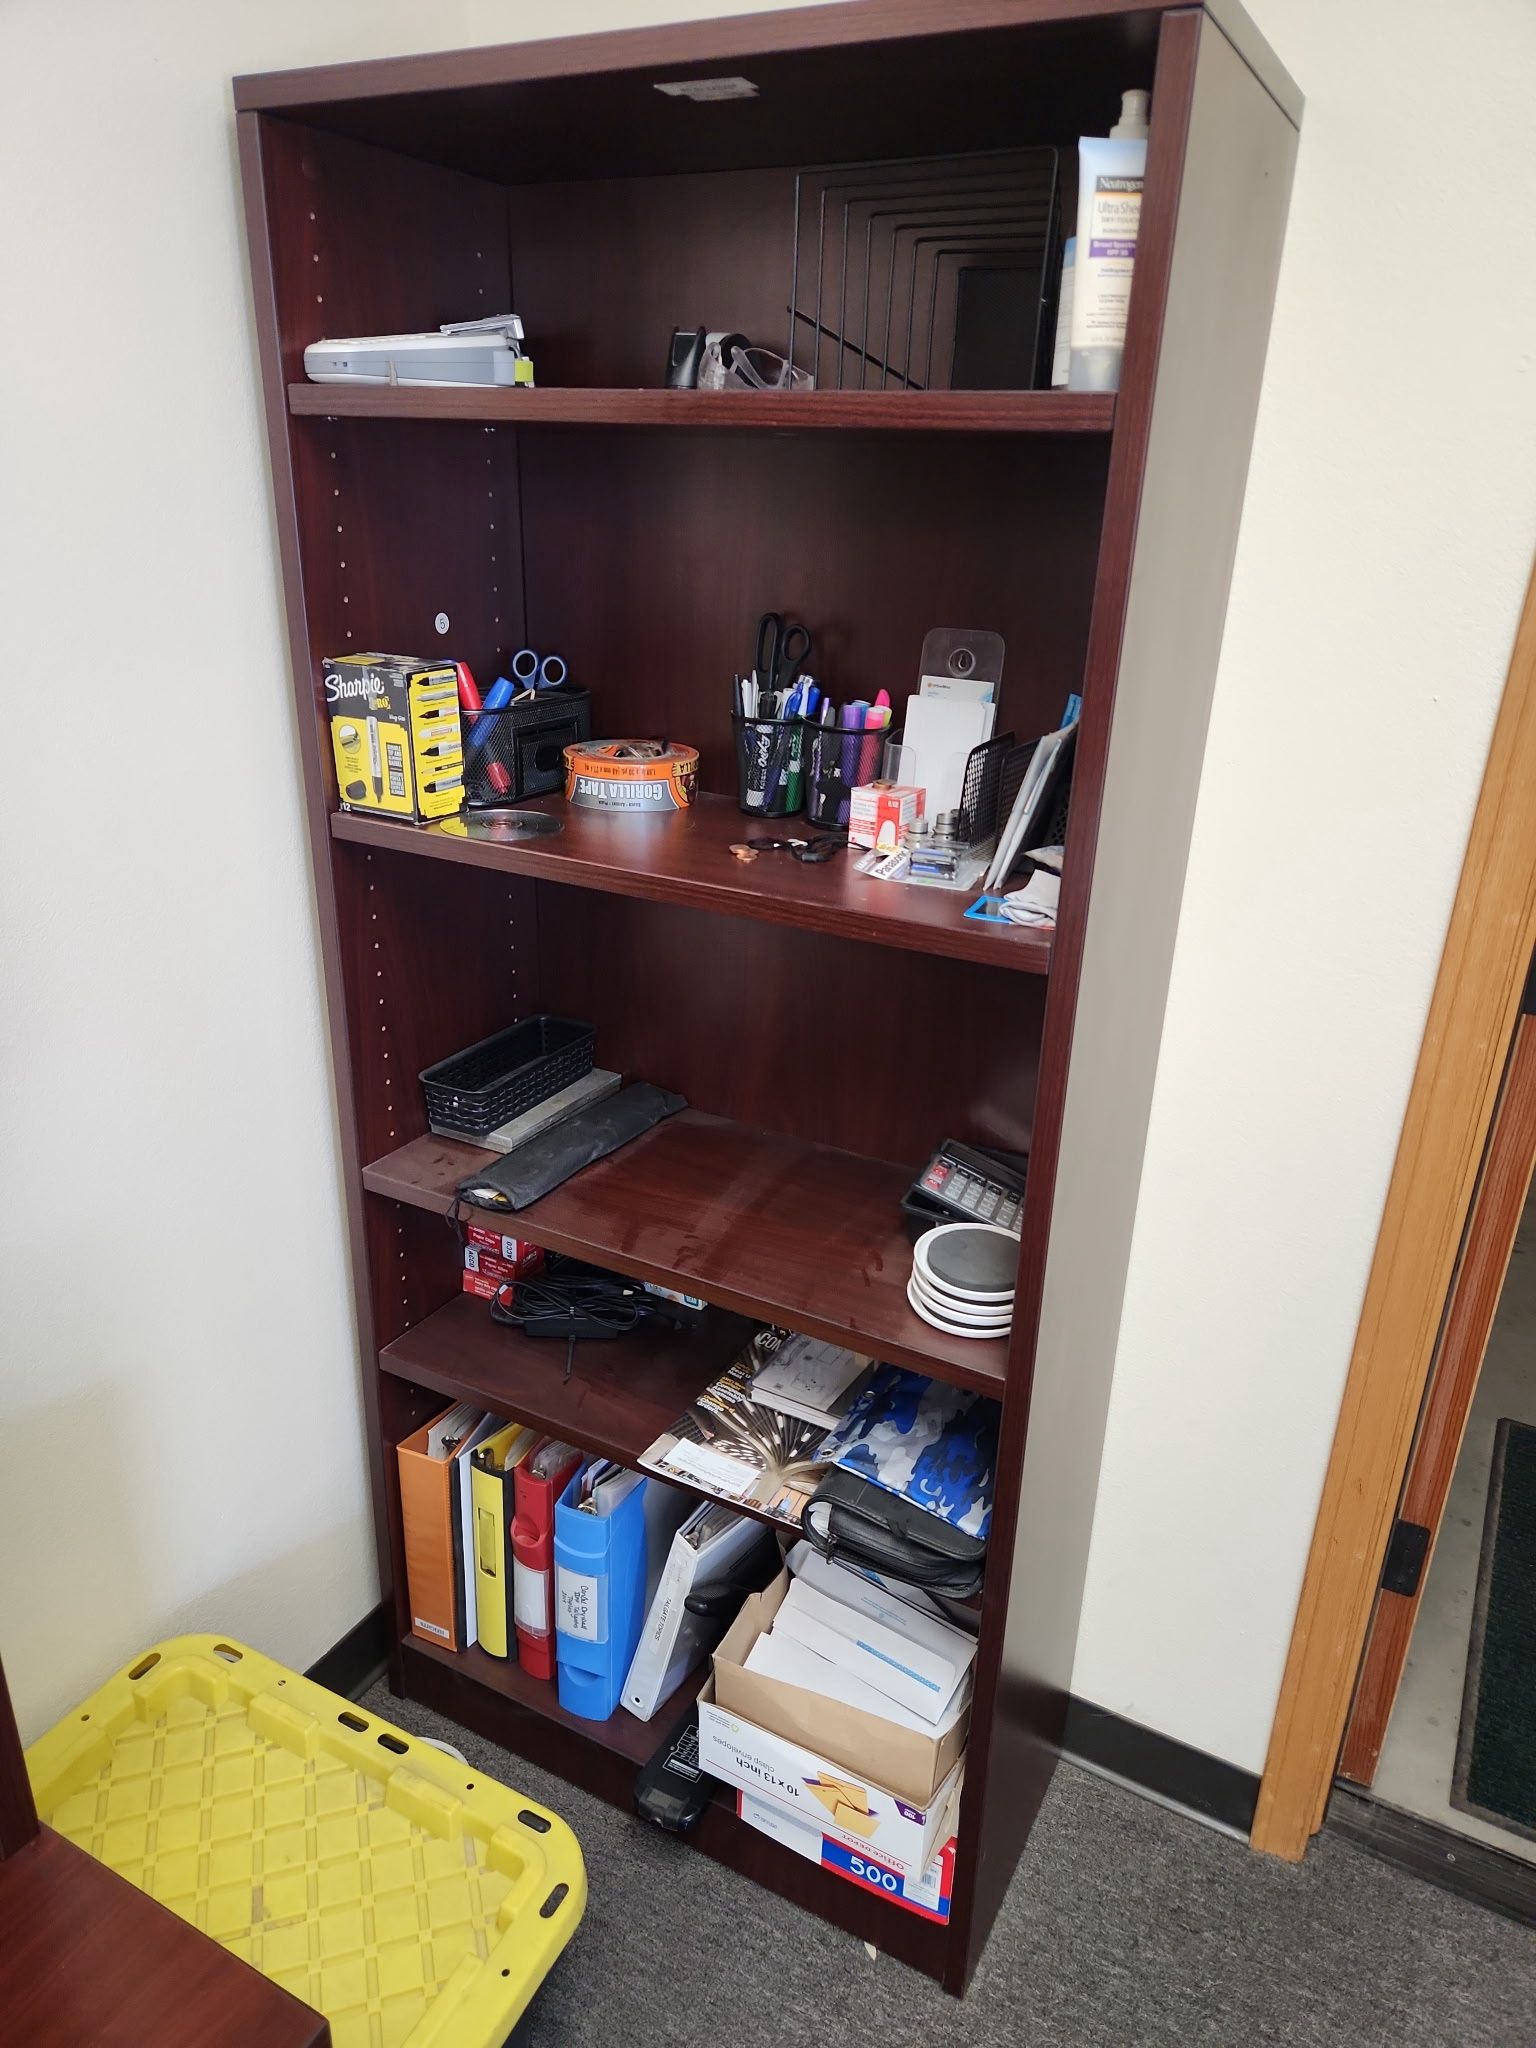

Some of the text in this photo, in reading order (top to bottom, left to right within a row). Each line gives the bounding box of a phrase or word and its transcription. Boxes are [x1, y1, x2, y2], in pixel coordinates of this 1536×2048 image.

[440, 618, 446, 629] 5
[325, 672, 385, 702] Sharpie
[580, 779, 663, 801] GORILLA TAPE
[655, 1597, 671, 1640] TAILGATE TOPICS
[712, 1735, 752, 1761] envelopes
[736, 1757, 761, 1777] inch
[754, 1757, 775, 1772] clasp
[764, 1772, 776, 1784] 13
[787, 1784, 800, 1796] 10
[842, 1834, 905, 1870] Office DEPOT
[850, 1855, 898, 1891] 500
